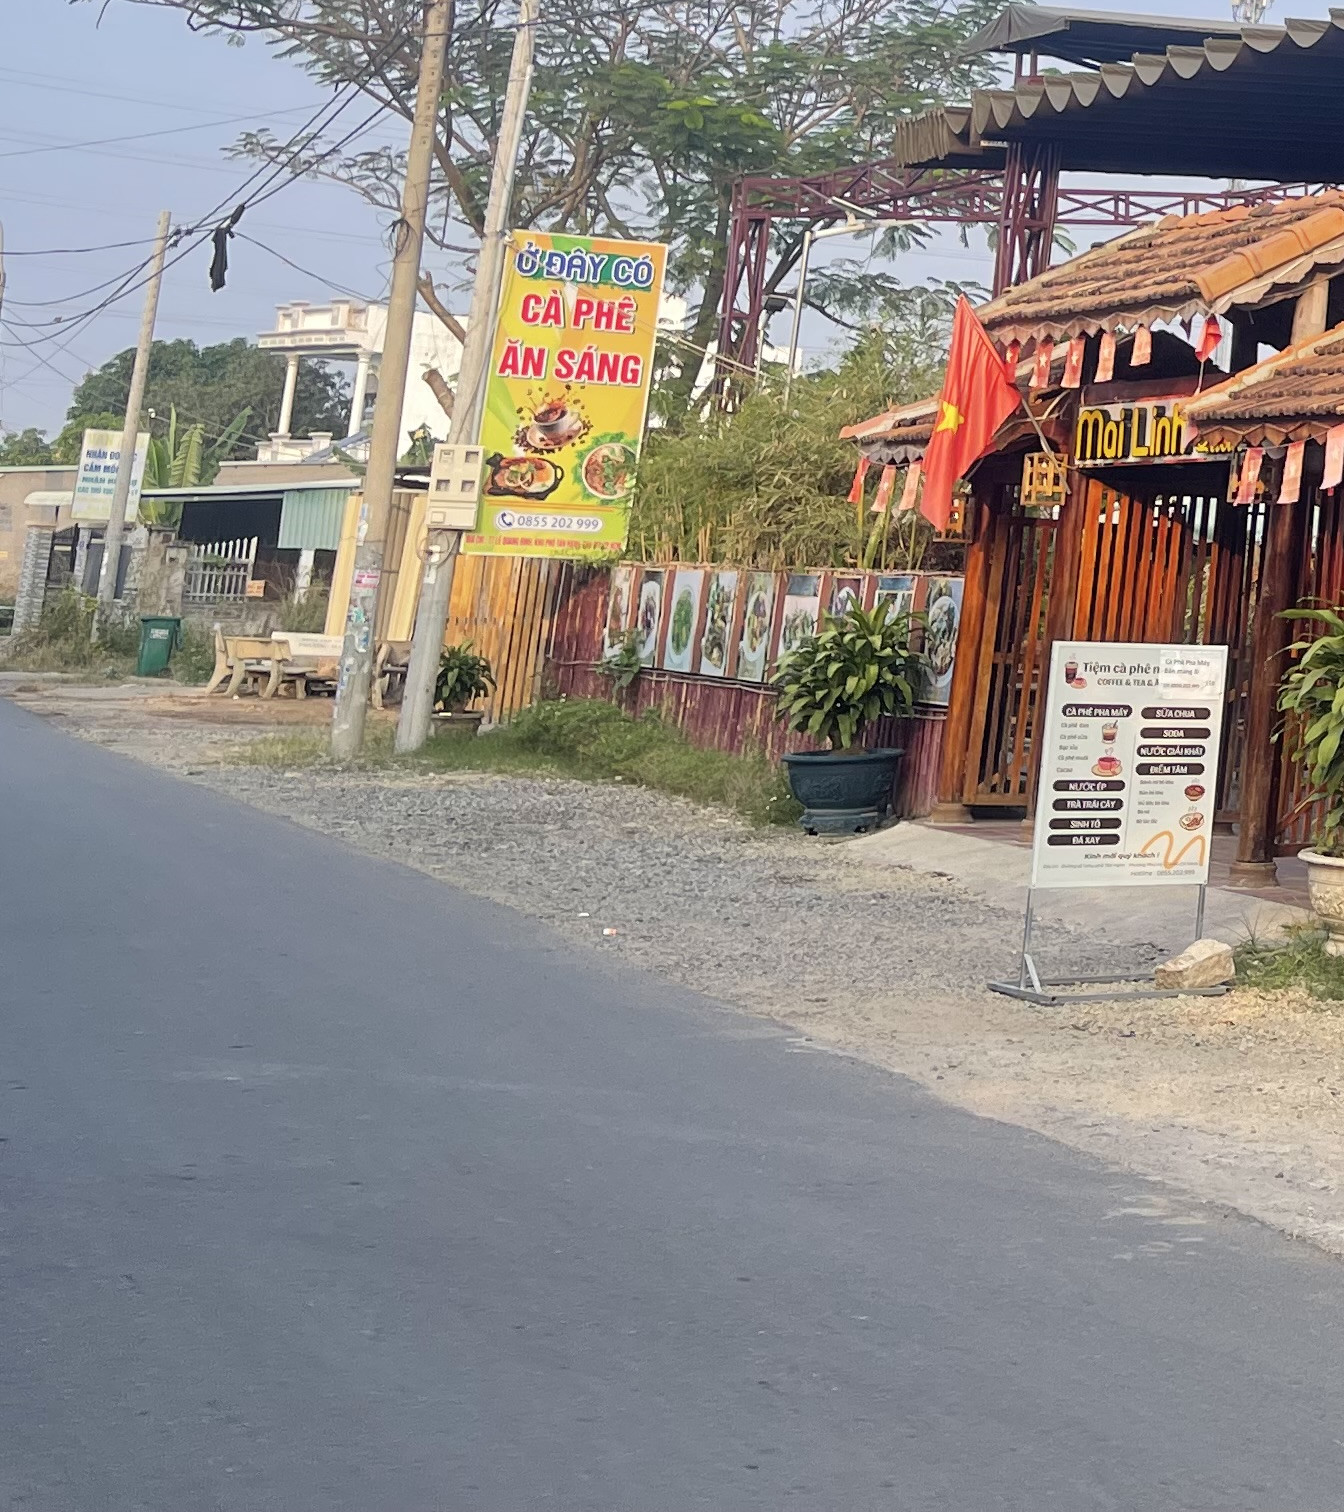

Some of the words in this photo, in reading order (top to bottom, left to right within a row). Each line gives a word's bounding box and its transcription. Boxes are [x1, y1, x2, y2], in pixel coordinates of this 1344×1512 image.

[516, 242, 540, 275] Ở
[545, 249, 607, 282] ĐÂY
[613, 255, 654, 286] CÓ
[521, 290, 563, 327] CÀ
[572, 296, 635, 332] PHÊ
[497, 338, 546, 378] ĂN
[554, 345, 642, 385] SÁNG
[1076, 408, 1130, 460] Mai
[1132, 402, 1187, 457] Linh
[518, 516, 548, 528] 0855
[551, 517, 573, 529] 202
[577, 518, 599, 530] 999
[1083, 661, 1111, 675] Tiệm
[1113, 662, 1127, 674] cà
[1129, 663, 1151, 676] phê
[1133, 678, 1146, 686] TEA
[1066, 707, 1077, 716] CÀ
[1078, 706, 1093, 717] PHÊ
[1094, 708, 1110, 717] PHA
[1155, 707, 1173, 718] SỮA
[1174, 709, 1195, 718] CHUA
[1162, 729, 1185, 738] SODA
[1140, 746, 1167, 756] NƯỚC
[1149, 764, 1171, 774] ĐIỂM
[1172, 765, 1188, 774] TÂM
[1068, 782, 1096, 791] NƯỚC
[1096, 781, 1107, 791] ÉP
[1067, 799, 1081, 809] TRÀ
[1082, 799, 1099, 809] TRÁI
[1100, 799, 1116, 809] CÂY
[1070, 820, 1090, 829] SINH
[1072, 835, 1084, 845] ĐÁ
[1084, 836, 1101, 845] XAY
